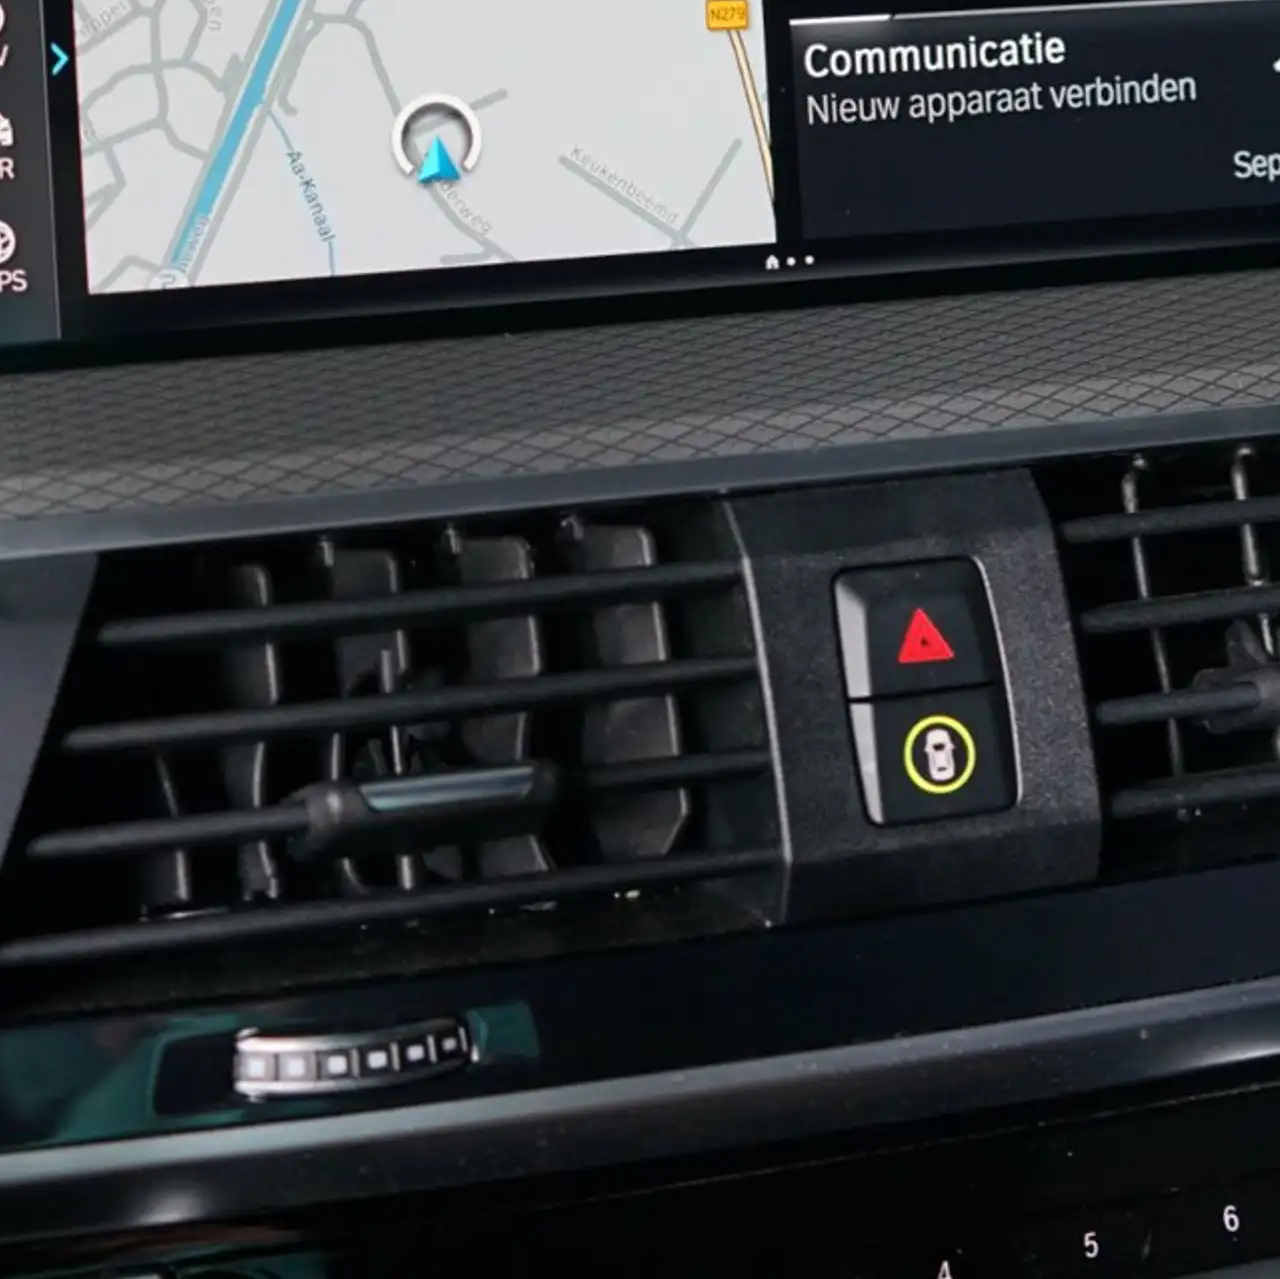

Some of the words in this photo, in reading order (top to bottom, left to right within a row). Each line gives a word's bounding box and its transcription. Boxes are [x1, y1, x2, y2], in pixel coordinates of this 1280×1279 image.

[805, 32, 1065, 77] Communicatie
[807, 93, 900, 124] Nieuw
[909, 82, 1043, 123] apparaat
[1050, 73, 1196, 108] verbinden
[1223, 1205, 1239, 1232] 6
[1084, 1232, 1098, 1258] 5
